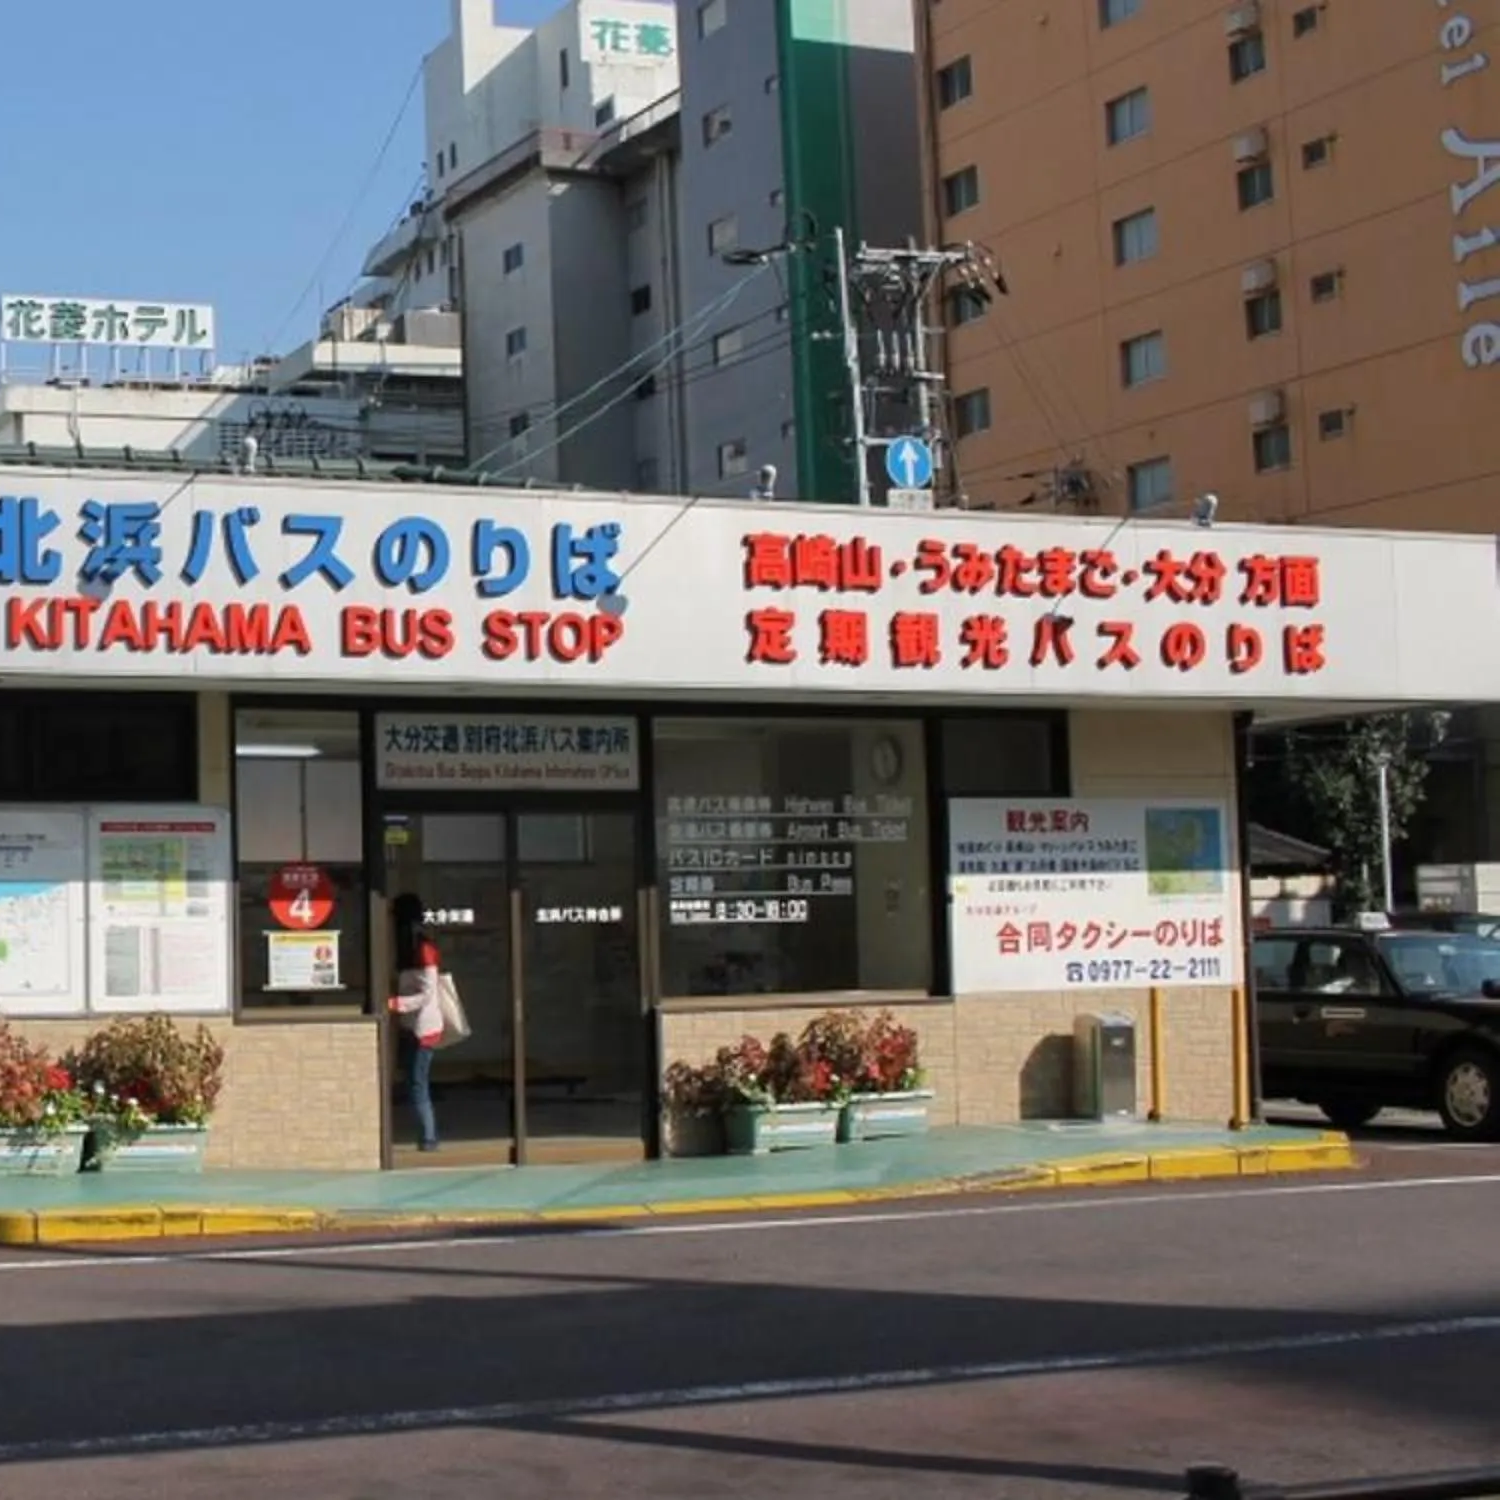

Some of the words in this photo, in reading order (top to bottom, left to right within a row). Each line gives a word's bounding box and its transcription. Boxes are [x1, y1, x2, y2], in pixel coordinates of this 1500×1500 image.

[6, 300, 207, 344] 花菱ホテル
[5, 596, 311, 657] KITAHAMA
[340, 606, 456, 659] BUS
[482, 608, 624, 663] STOP
[746, 606, 1326, 675] 定期観光バスのりば
[1005, 809, 1088, 833] 観光案内
[288, 889, 314, 925] 4
[996, 916, 1224, 955] 合同タクシーのりば
[1087, 957, 1221, 982] 0977-22-2111
